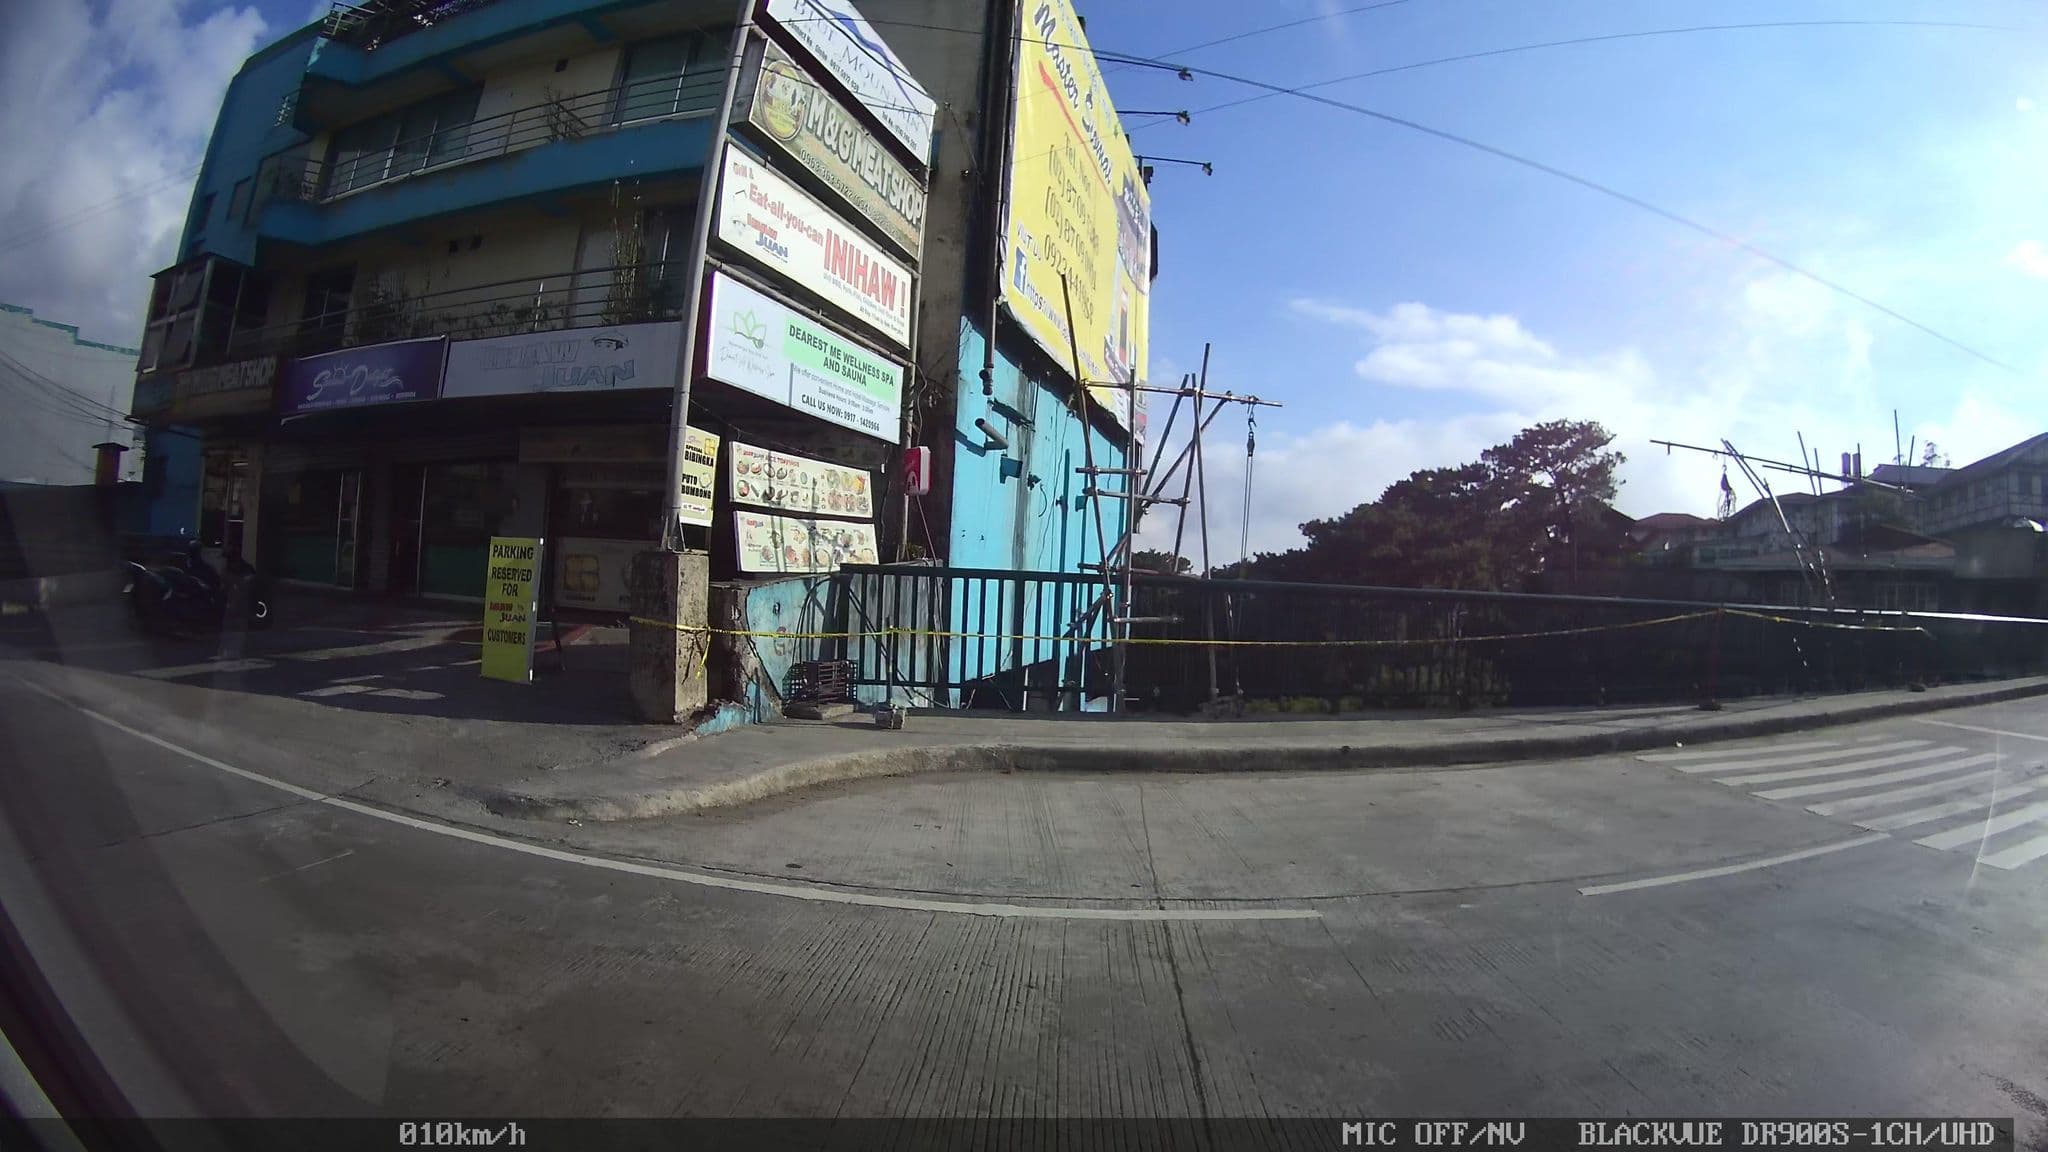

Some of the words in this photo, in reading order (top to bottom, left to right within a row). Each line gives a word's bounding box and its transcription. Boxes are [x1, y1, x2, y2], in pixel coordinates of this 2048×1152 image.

[750, 182, 824, 247] Eat-all-you-can
[755, 232, 788, 258] JUAN
[824, 228, 897, 312] INIHAW
[789, 324, 829, 354] DEAREST
[829, 345, 842, 361] ME
[842, 351, 881, 380] WELLNESS
[880, 371, 895, 388] SPA
[823, 357, 840, 373] AND
[841, 366, 867, 387] SAUNA
[801, 394, 816, 408] CALL
[817, 400, 826, 411] US
[826, 404, 843, 418] NOW:
[684, 451, 714, 468] BIBINGKA
[682, 473, 698, 486] PUTO
[681, 485, 712, 500] BUMBONG
[492, 545, 534, 560] PARKING
[491, 567, 533, 582] RESERVED
[502, 583, 518, 597] FOR
[500, 612, 527, 623] JUAN
[488, 628, 526, 646] CUSTOMERS
